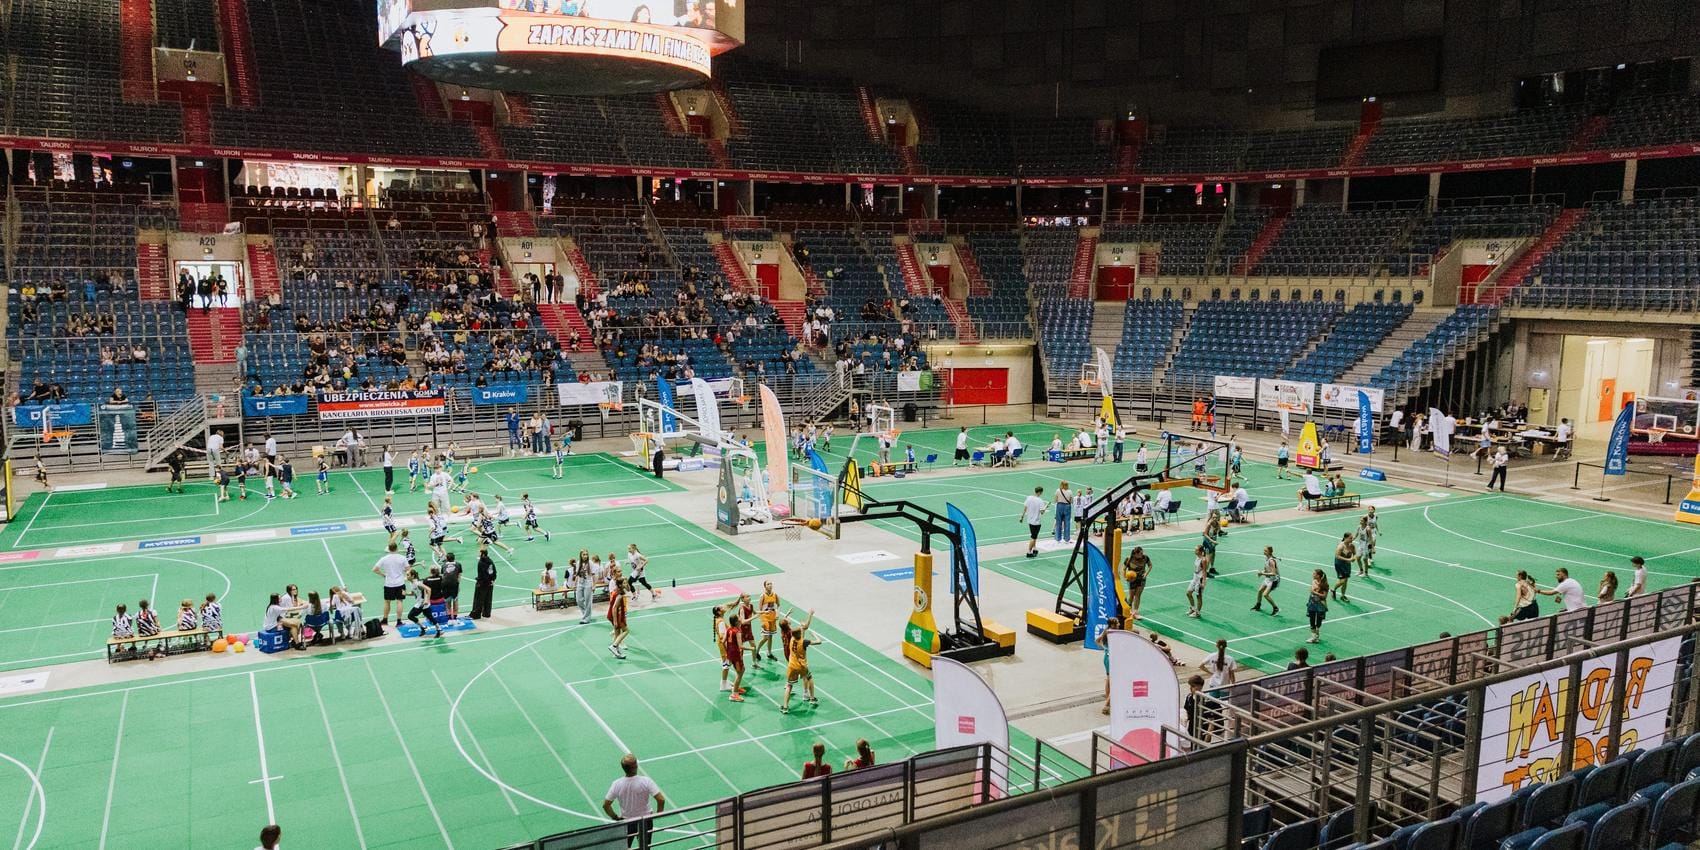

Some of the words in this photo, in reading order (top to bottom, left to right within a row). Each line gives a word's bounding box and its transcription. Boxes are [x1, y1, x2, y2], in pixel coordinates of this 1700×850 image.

[528, 24, 641, 51] ZAPRASZAMY
[641, 32, 660, 54] NA
[200, 237, 216, 246] A20
[1486, 243, 1500, 252] A05
[324, 390, 408, 402] UBEZPIECZENIA
[1613, 420, 1626, 456] Kraków
